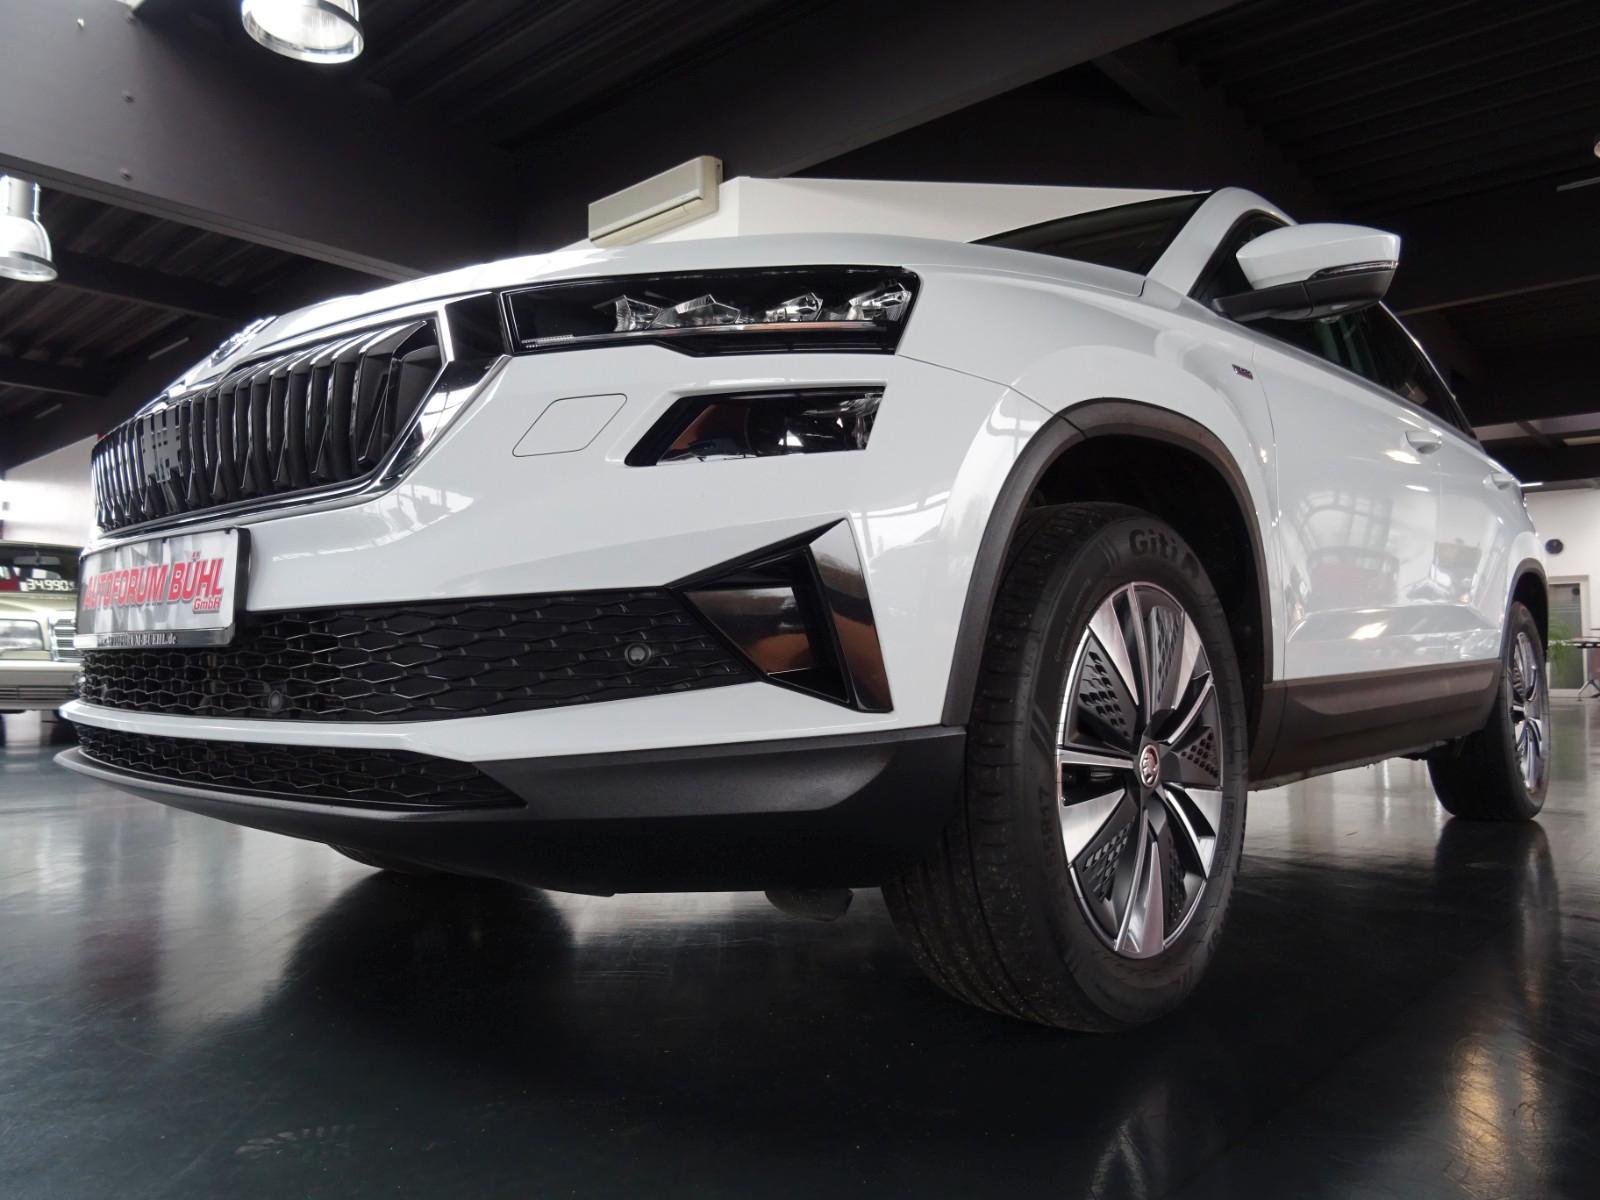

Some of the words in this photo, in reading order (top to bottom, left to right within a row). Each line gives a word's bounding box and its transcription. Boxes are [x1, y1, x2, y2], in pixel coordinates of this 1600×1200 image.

[1129, 528, 1178, 560] Giti
[84, 564, 169, 610] AUTOFORUM
[168, 551, 224, 603] BÜHL
[193, 597, 221, 612] GmbH
